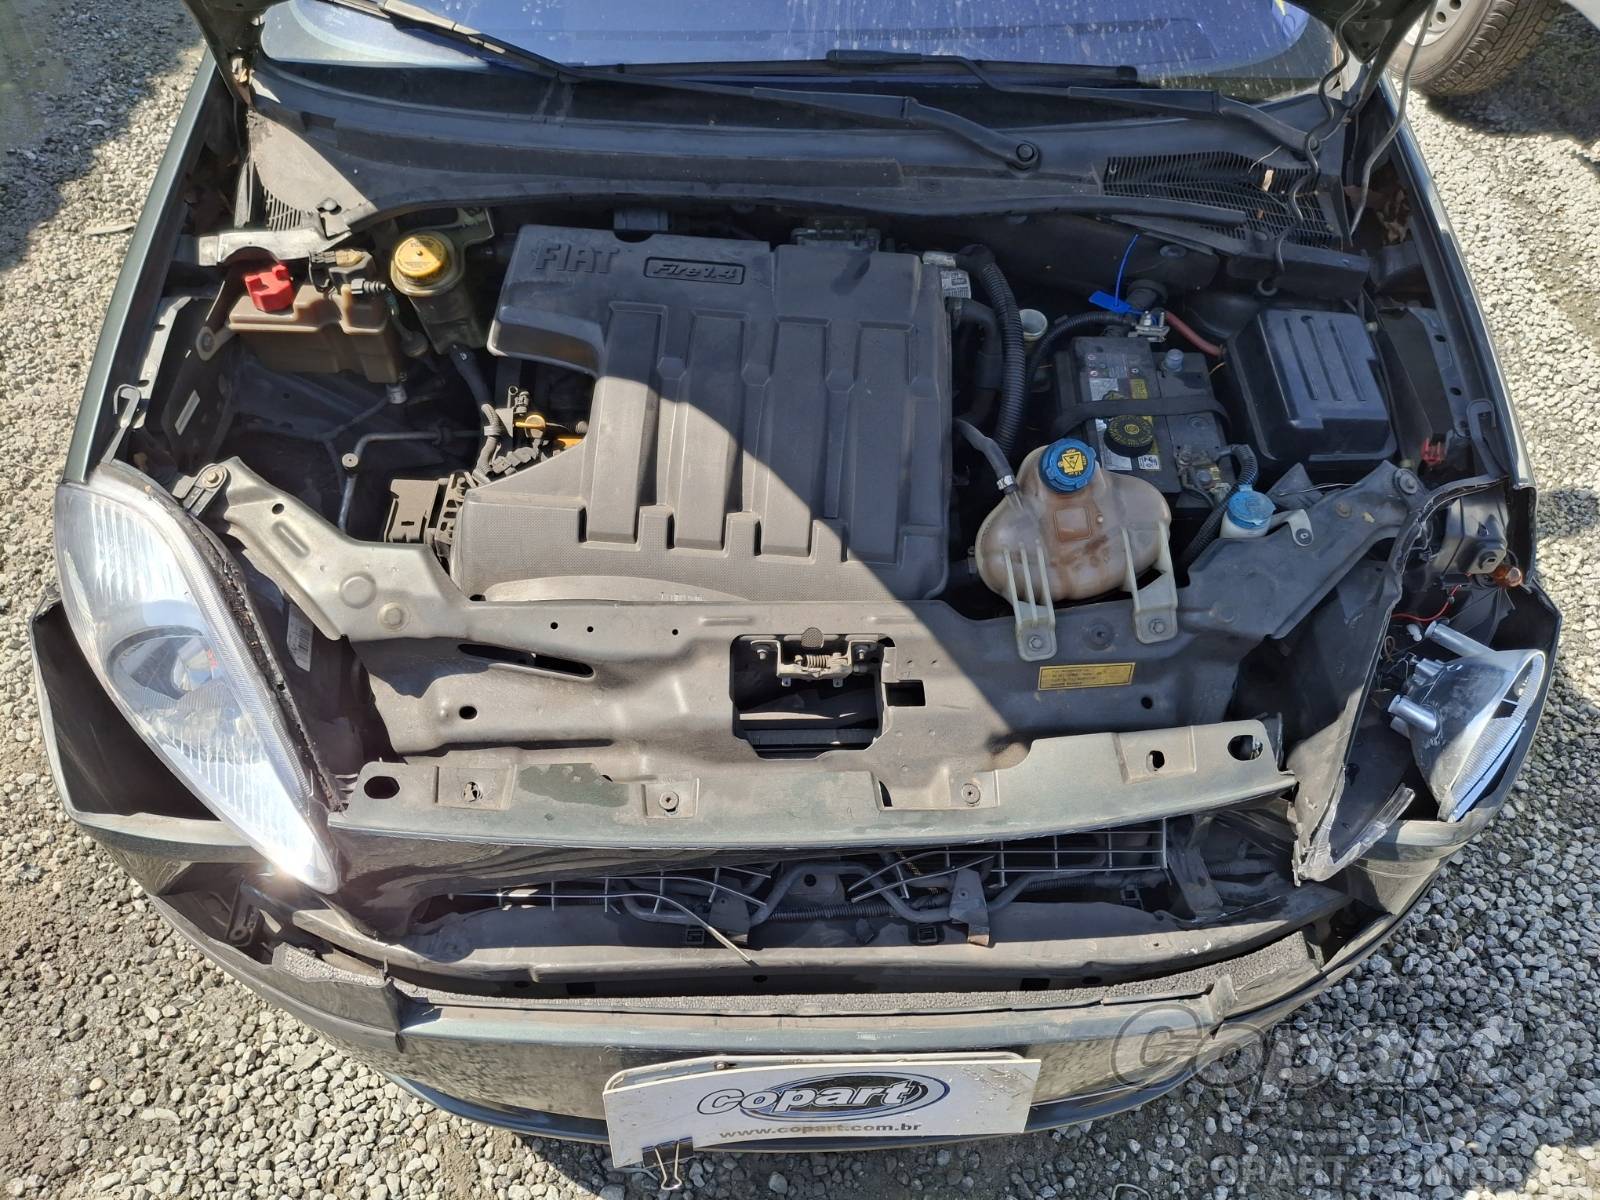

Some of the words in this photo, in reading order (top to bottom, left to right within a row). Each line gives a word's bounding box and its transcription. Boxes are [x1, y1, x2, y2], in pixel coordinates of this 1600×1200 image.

[535, 243, 620, 274] FIAT
[697, 1078, 922, 1116] Copart
[719, 1123, 922, 1139] www.copart.com.br
